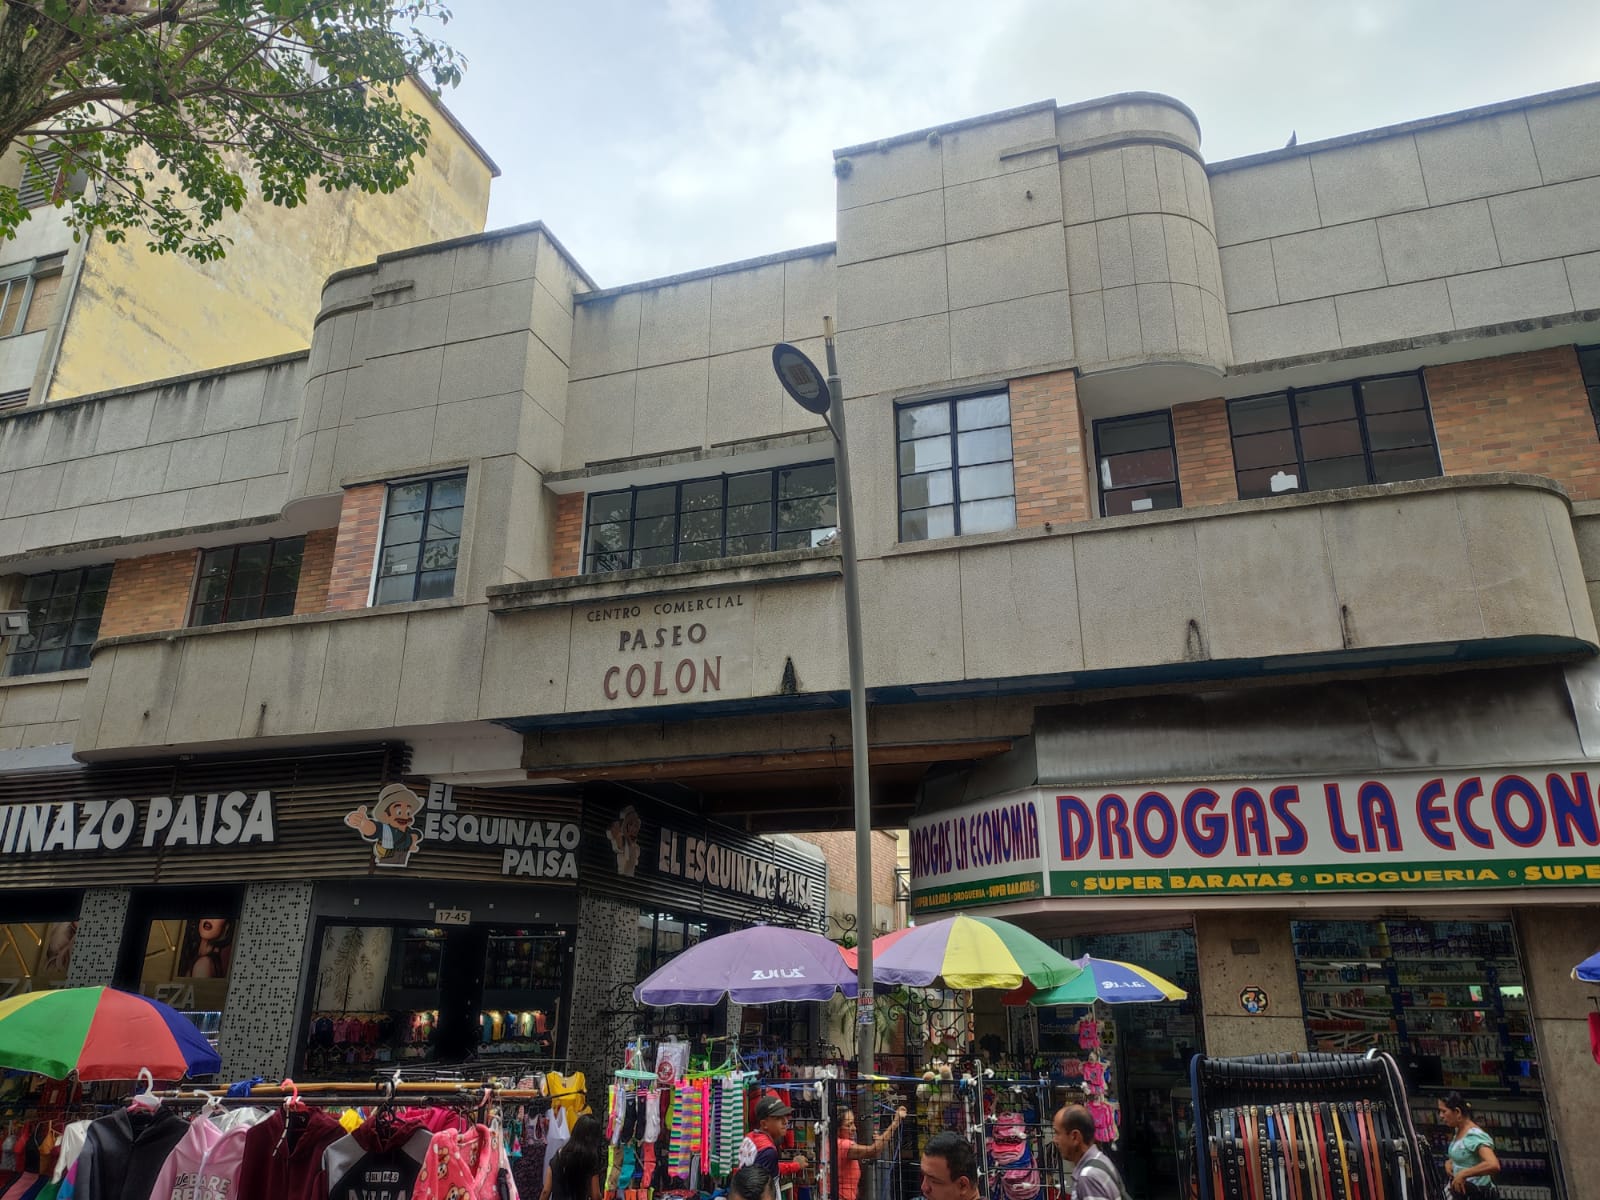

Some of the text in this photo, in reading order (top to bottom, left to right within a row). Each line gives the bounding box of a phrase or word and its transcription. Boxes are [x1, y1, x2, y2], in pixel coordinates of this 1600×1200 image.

[586, 594, 743, 622] CENTRO COMERCIAL
[618, 622, 707, 651] PASEO
[603, 655, 722, 700] COLON
[427, 783, 457, 811] EL
[142, 790, 274, 848] PAISA
[424, 812, 581, 850] ESQUINAZO
[1056, 772, 1600, 861] DROGAS LA ECON
[911, 801, 1040, 879] DROGAS LA ECONOMIA
[501, 848, 579, 879] PAISA
[658, 826, 814, 912] EL ESQUINAZO PAISA
[1083, 876, 1164, 891] SUPER
[1169, 872, 1294, 889] BARATAS
[1315, 869, 1499, 884] DROGUERIA
[439, 911, 467, 922] 17-45
